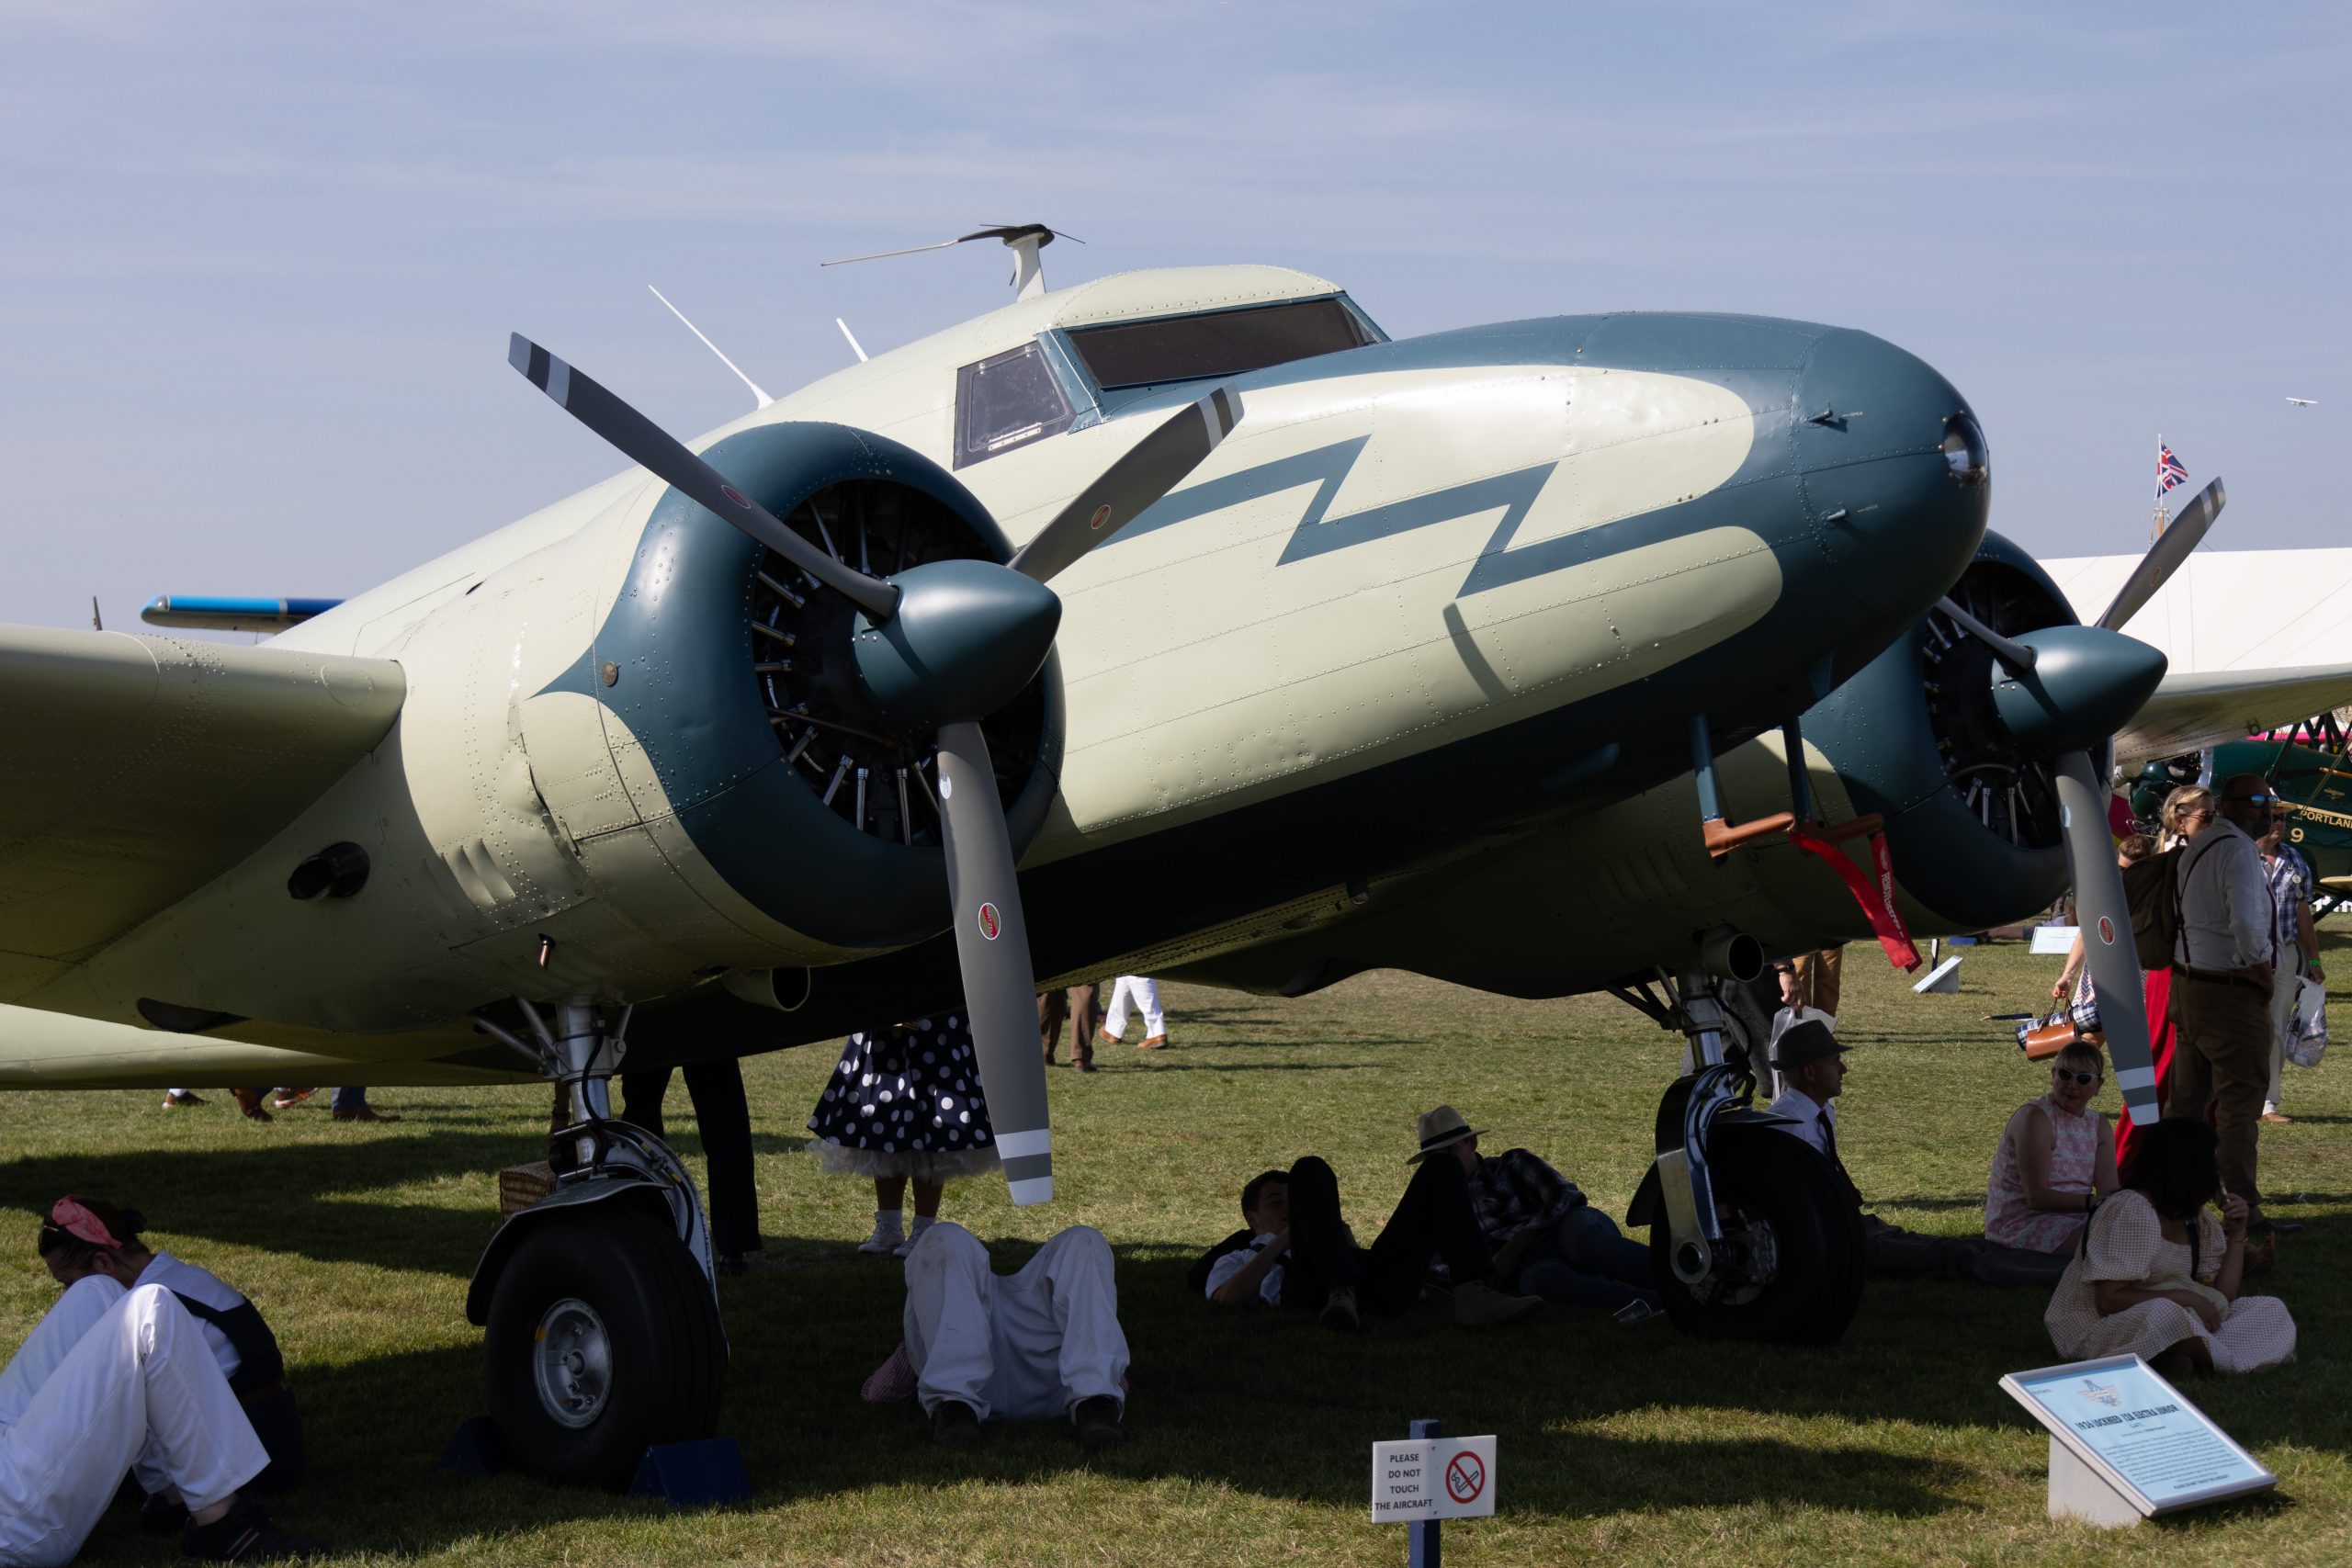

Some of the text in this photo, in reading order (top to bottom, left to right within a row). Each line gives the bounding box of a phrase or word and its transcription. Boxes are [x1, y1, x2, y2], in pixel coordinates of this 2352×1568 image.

[2300, 810, 2352, 829] PORTLAN
[2290, 828, 2304, 843] 9
[2091, 1415, 2123, 1427] LOCKHEED
[2132, 1409, 2159, 1419] ELECTRA
[2154, 1404, 2179, 1415] JUNIOR
[1389, 1453, 1419, 1462] PLEASE
[1388, 1469, 1421, 1479] DO NOT
[1389, 1484, 1419, 1494] TOUCH
[1374, 1498, 1433, 1511] THE AIRCRAFT
